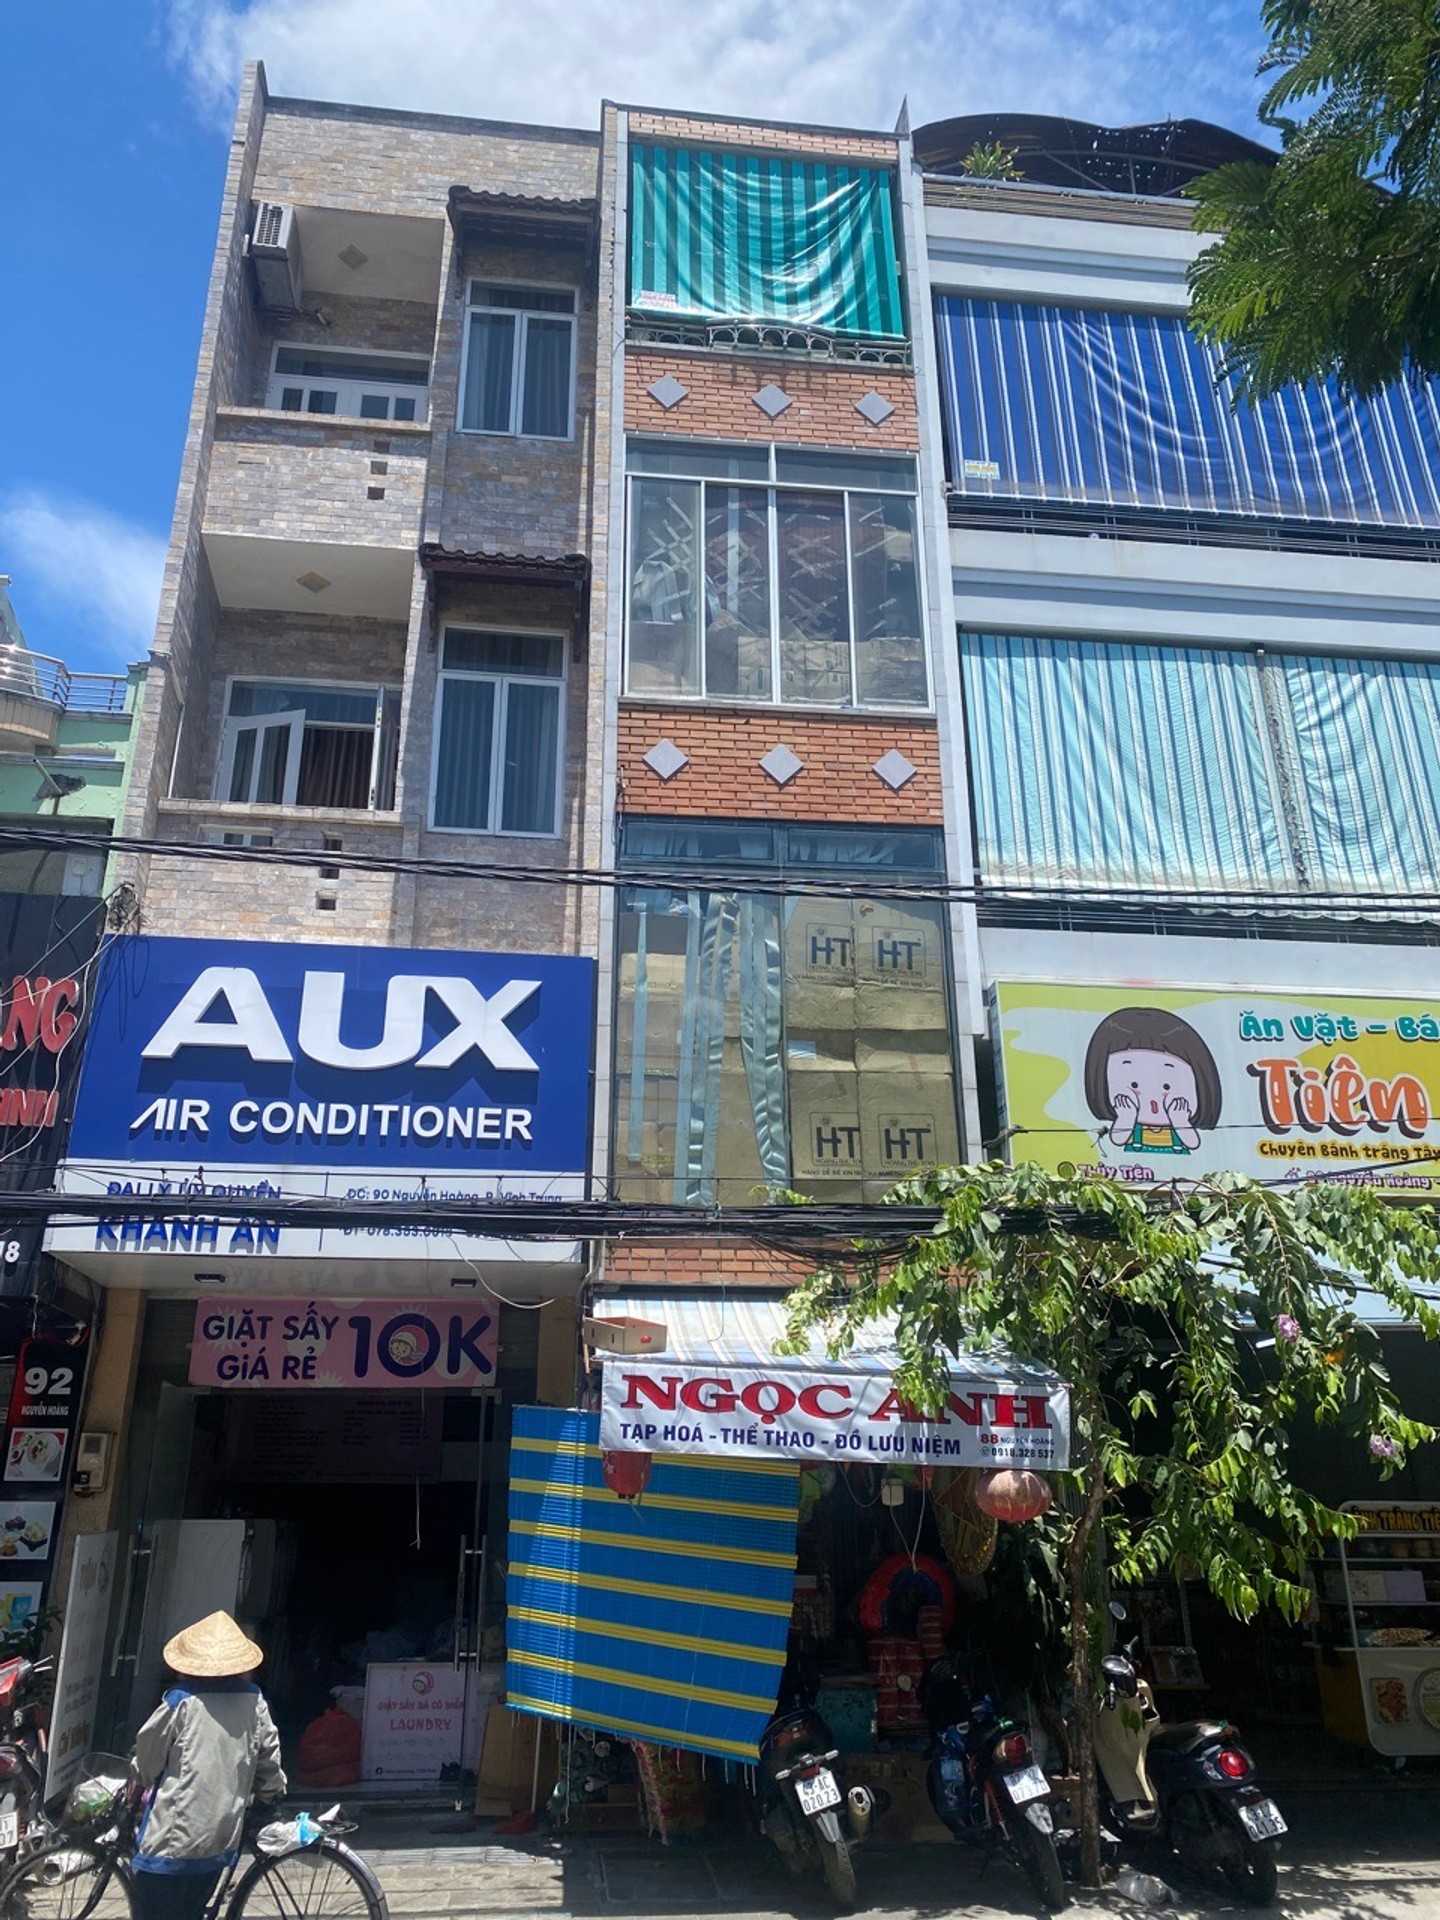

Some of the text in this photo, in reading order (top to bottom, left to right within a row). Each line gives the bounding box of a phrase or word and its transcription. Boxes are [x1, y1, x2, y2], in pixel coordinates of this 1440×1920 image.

[877, 939, 922, 970] HT
[0, 975, 79, 1053] NG
[141, 966, 542, 1072] AUX
[1240, 1010, 1285, 1041] Ăn
[1291, 1013, 1359, 1046] Vật
[1250, 1055, 1429, 1138] Tiên
[130, 1098, 533, 1140] AIR CONDITIONER
[884, 1128, 931, 1159] HT
[1259, 1141, 1316, 1157] Chuyên
[1120, 1163, 1154, 1181] Tiên
[373, 1189, 390, 1200] 90
[203, 1301, 340, 1348] GIẶT SẤY
[348, 1312, 493, 1378] 10K
[281, 1346, 318, 1380] RẺ
[24, 1367, 73, 1395] 92
[620, 1374, 853, 1424] NGỌC
[620, 1423, 656, 1443] TẠP
[663, 1423, 704, 1442] HOÁ
[720, 1423, 757, 1445] THỂ
[764, 1430, 815, 1448] THAO
[835, 1428, 862, 1450] ĐỒ
[868, 1433, 905, 1454] LƯU
[912, 1434, 961, 1458] NIỆM
[981, 1434, 999, 1444] 88
[390, 1719, 452, 1731] LAUNDRY
